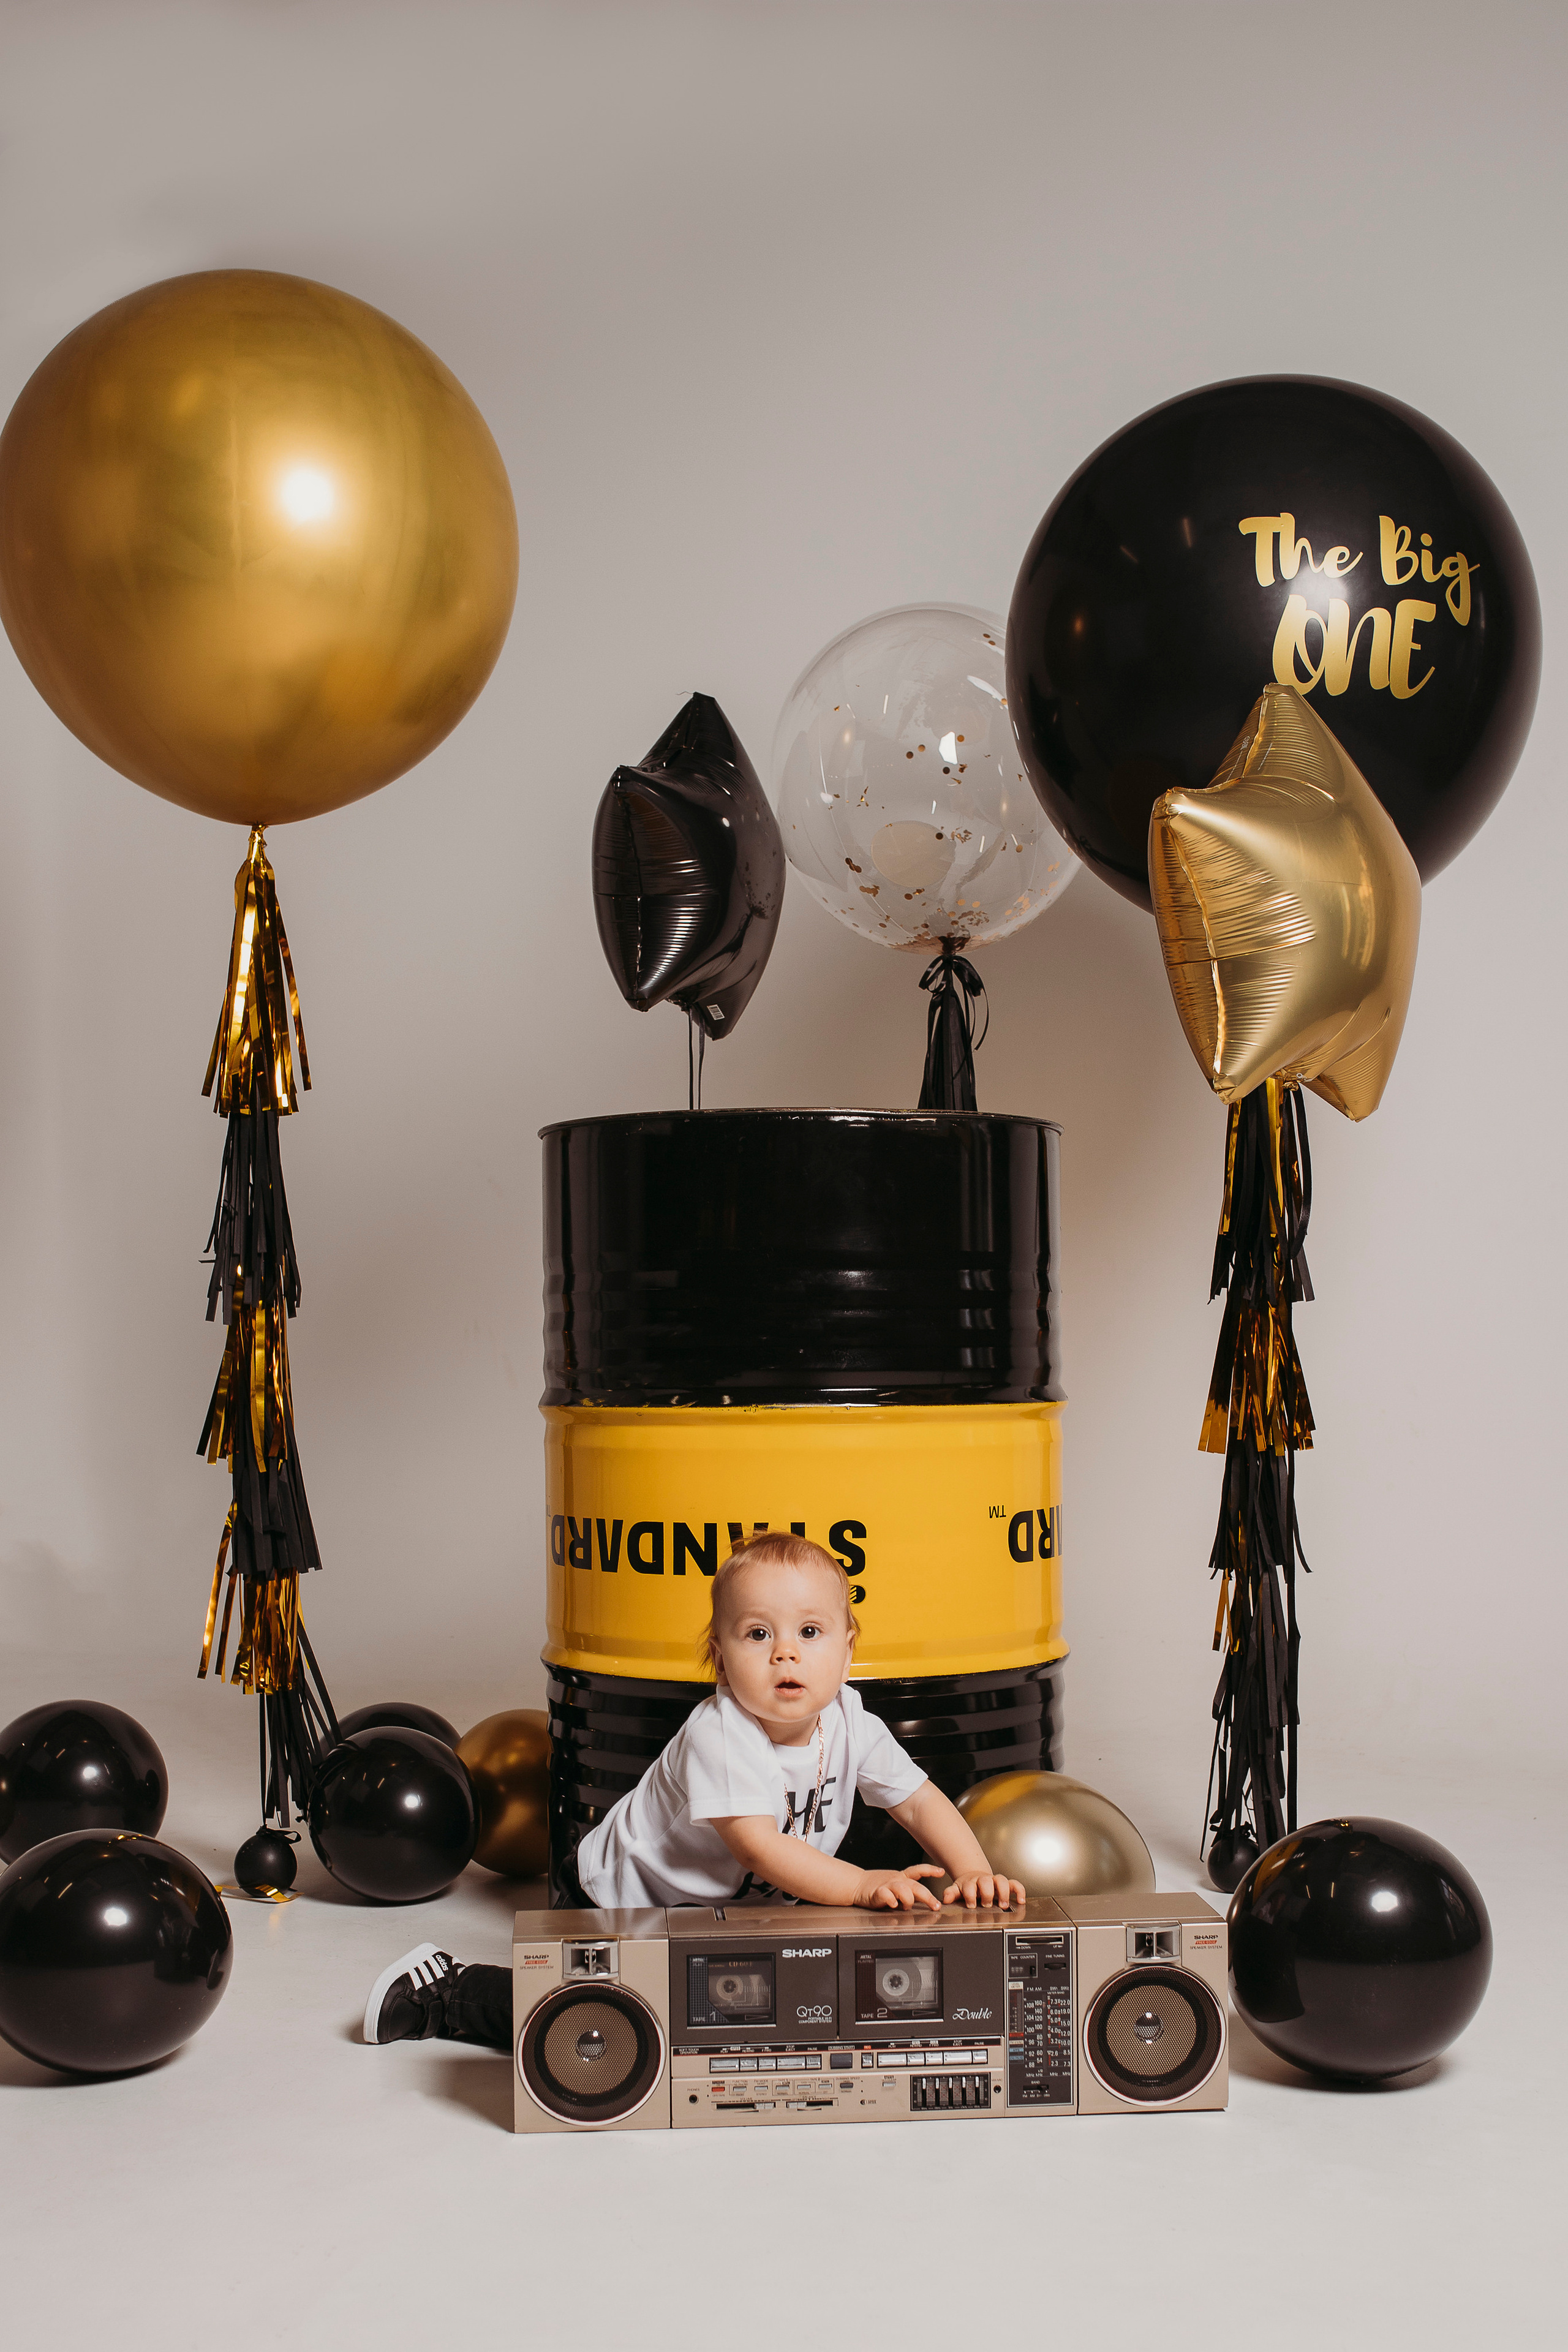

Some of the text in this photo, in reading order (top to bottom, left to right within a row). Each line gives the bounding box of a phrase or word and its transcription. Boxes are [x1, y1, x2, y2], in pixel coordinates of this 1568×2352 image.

[1238, 512, 1480, 626] The Big
[782, 1948, 832, 1958] SHARP
[435, 1954, 448, 1971] adidas
[710, 2011, 716, 2021] 1
[796, 2005, 832, 2017] QT90
[877, 2008, 888, 2018] 2
[952, 2007, 992, 2020] Double
